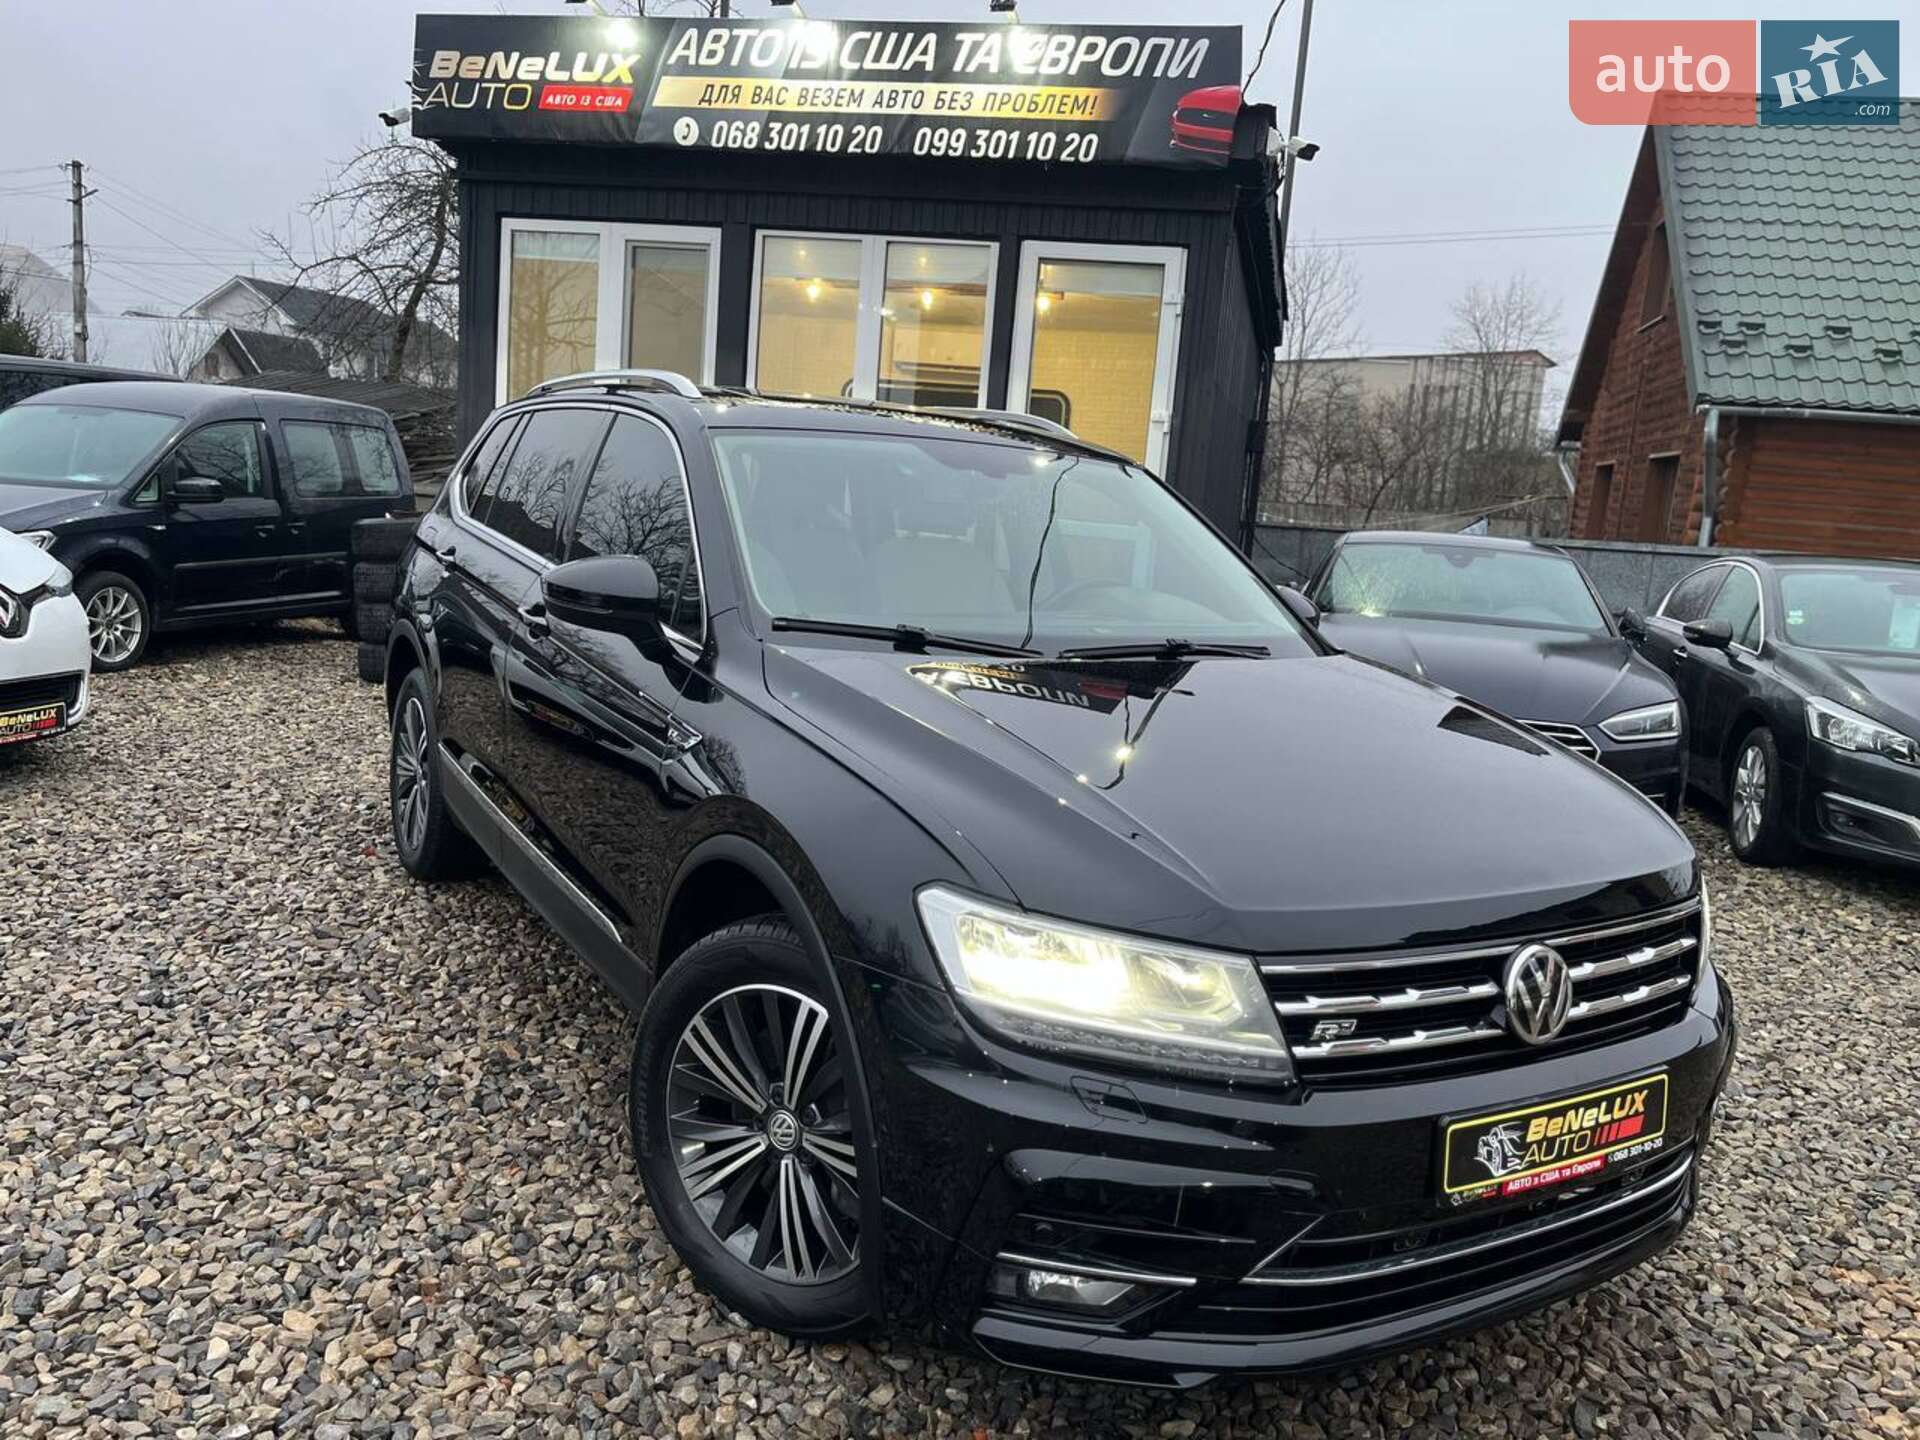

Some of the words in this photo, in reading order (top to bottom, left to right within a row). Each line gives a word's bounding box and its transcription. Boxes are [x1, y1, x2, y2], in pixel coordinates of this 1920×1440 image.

[429, 50, 642, 83] BeNeLUX
[668, 27, 784, 68] АВТО
[840, 30, 937, 72] США
[952, 32, 1001, 73] ТА
[423, 82, 532, 110] AUTO
[546, 94, 576, 106] АВТО
[595, 95, 623, 107] США
[698, 83, 742, 106] ДЛЯ
[751, 86, 789, 106] ВАС
[797, 87, 865, 108] ВЕЗЕМ
[872, 89, 923, 109] АВТО
[934, 90, 972, 110] БЕЗ
[983, 92, 1100, 115] ПРОБЛЕМ!
[711, 120, 761, 149] 068
[764, 122, 811, 152] 301
[815, 124, 844, 153] 10
[847, 125, 884, 154] 20
[913, 126, 970, 157] 099
[970, 128, 1018, 160] 301
[1026, 130, 1054, 161] 10
[1060, 132, 1100, 163] 20
[1526, 1089, 1649, 1143] BeNeLUX
[1521, 1130, 1591, 1169] AUTO
[1507, 1176, 1532, 1192] АВТО
[1540, 1169, 1560, 1183] США
